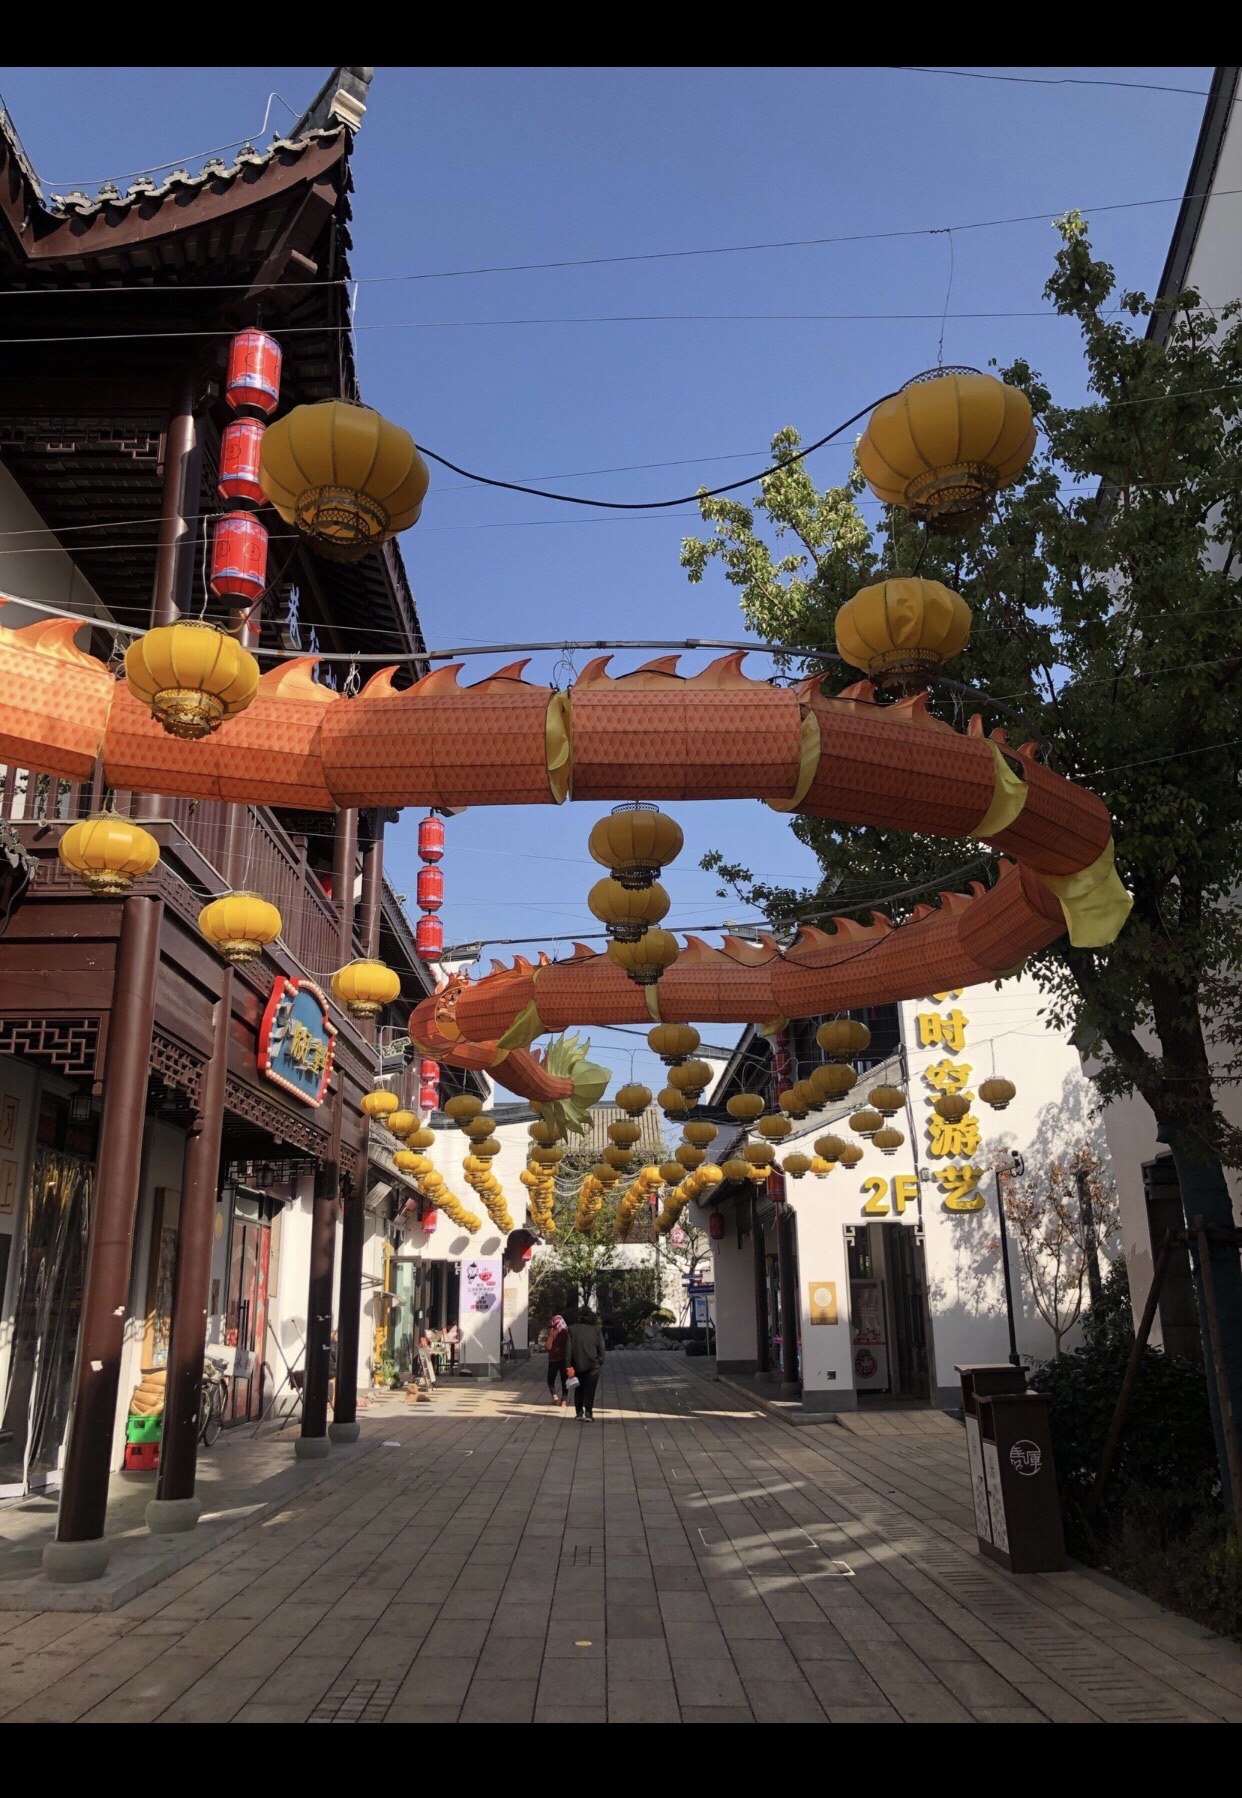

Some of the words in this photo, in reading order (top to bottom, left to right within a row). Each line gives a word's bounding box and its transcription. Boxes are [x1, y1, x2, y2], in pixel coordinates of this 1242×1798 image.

[917, 988, 986, 1210] 时空游艺
[864, 1176, 919, 1213] 2F
